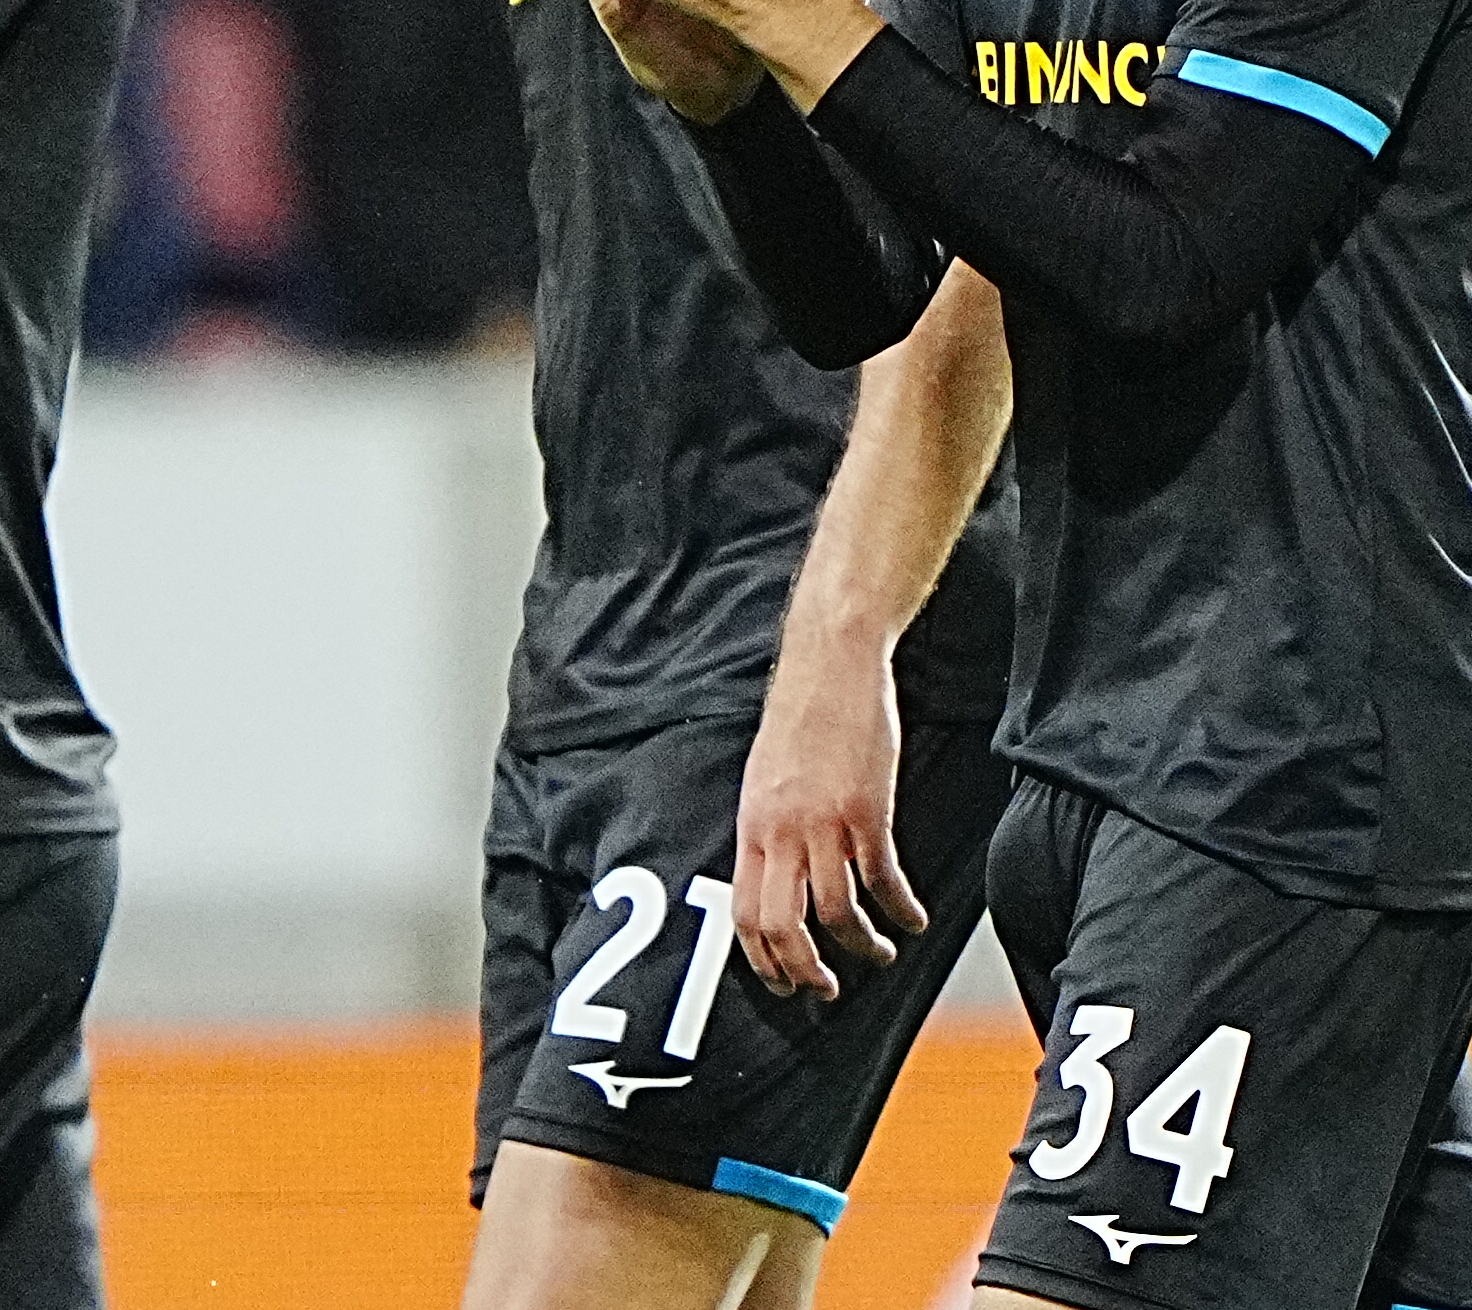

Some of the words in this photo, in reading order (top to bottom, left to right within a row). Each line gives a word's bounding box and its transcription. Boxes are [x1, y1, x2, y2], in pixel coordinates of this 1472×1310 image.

[975, 39, 1166, 107] BINNC
[550, 865, 735, 1061] 21
[1029, 1004, 1251, 1214] 34
